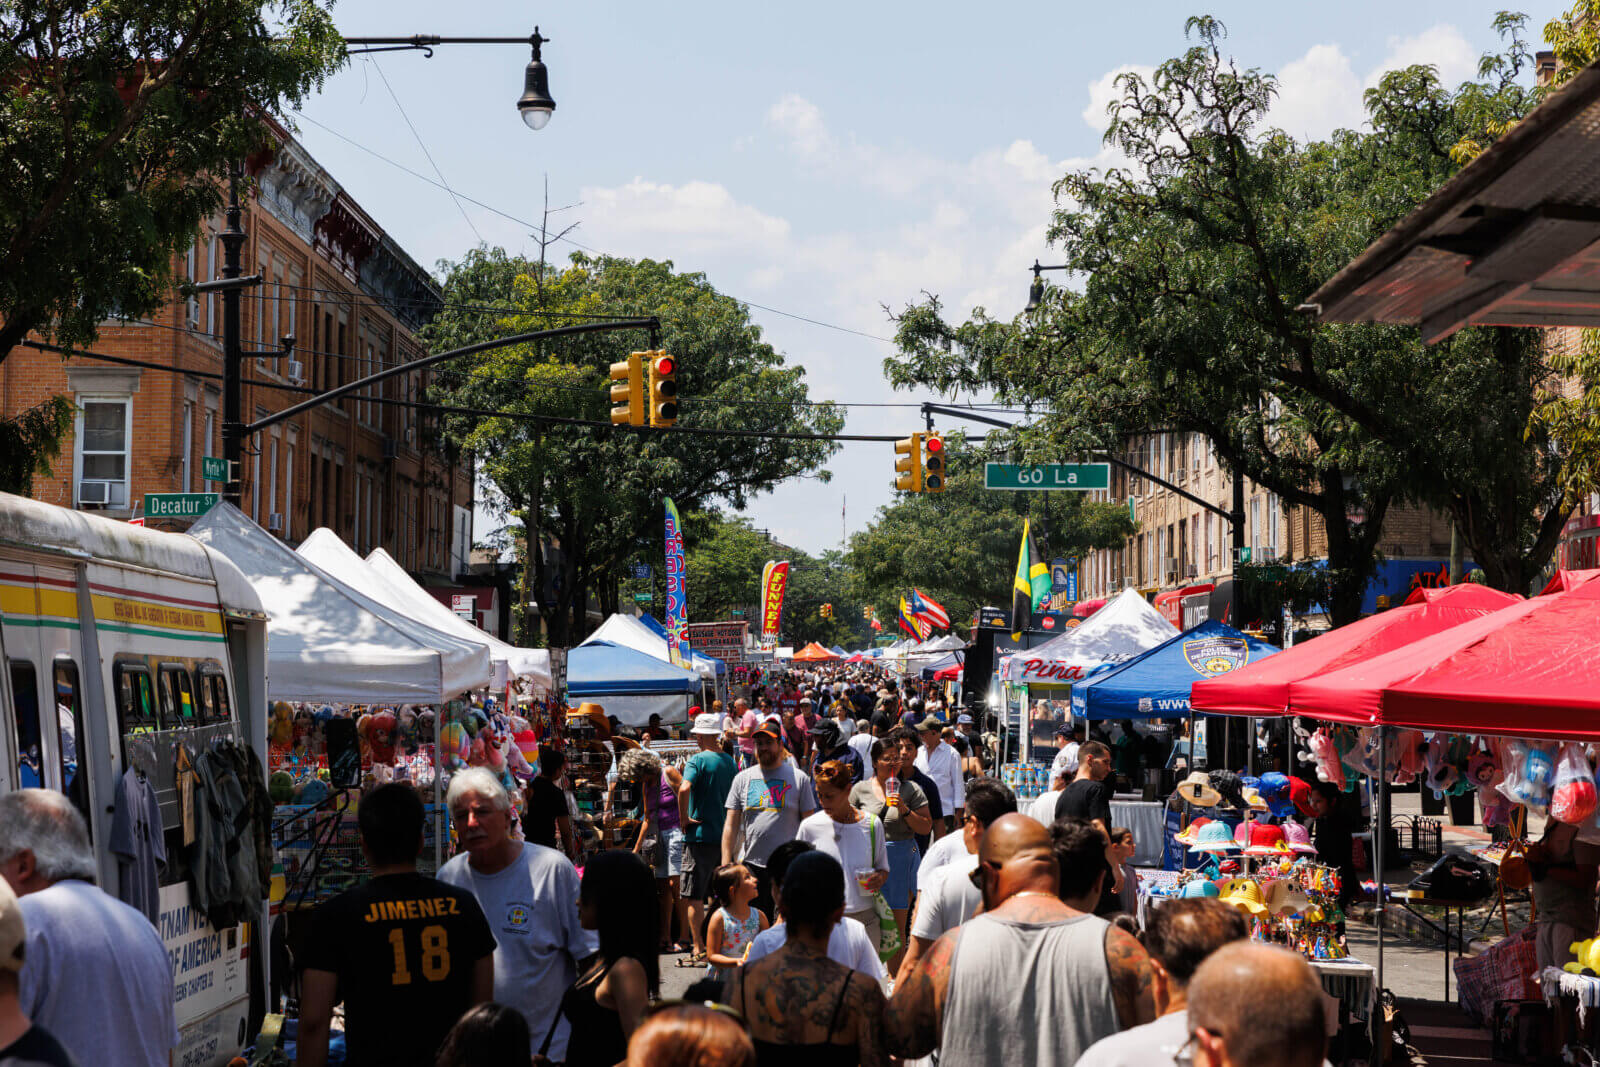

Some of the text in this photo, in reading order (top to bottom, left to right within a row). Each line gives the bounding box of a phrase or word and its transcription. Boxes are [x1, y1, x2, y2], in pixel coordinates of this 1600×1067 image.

[206, 459, 220, 478] Myrtle
[1055, 469, 1078, 484] La
[152, 496, 213, 514] Decatur St
[766, 572, 785, 630] FUNNEL
[1190, 651, 1244, 660] DEPARTMENT
[1201, 646, 1231, 657] POLICE
[1021, 658, 1085, 681] Piña
[364, 897, 461, 923] JIMENEZ
[160, 904, 190, 942] TNAM
[180, 932, 222, 975] AMERICA
[388, 924, 450, 985] 18
[188, 971, 208, 997] CHAPTER
